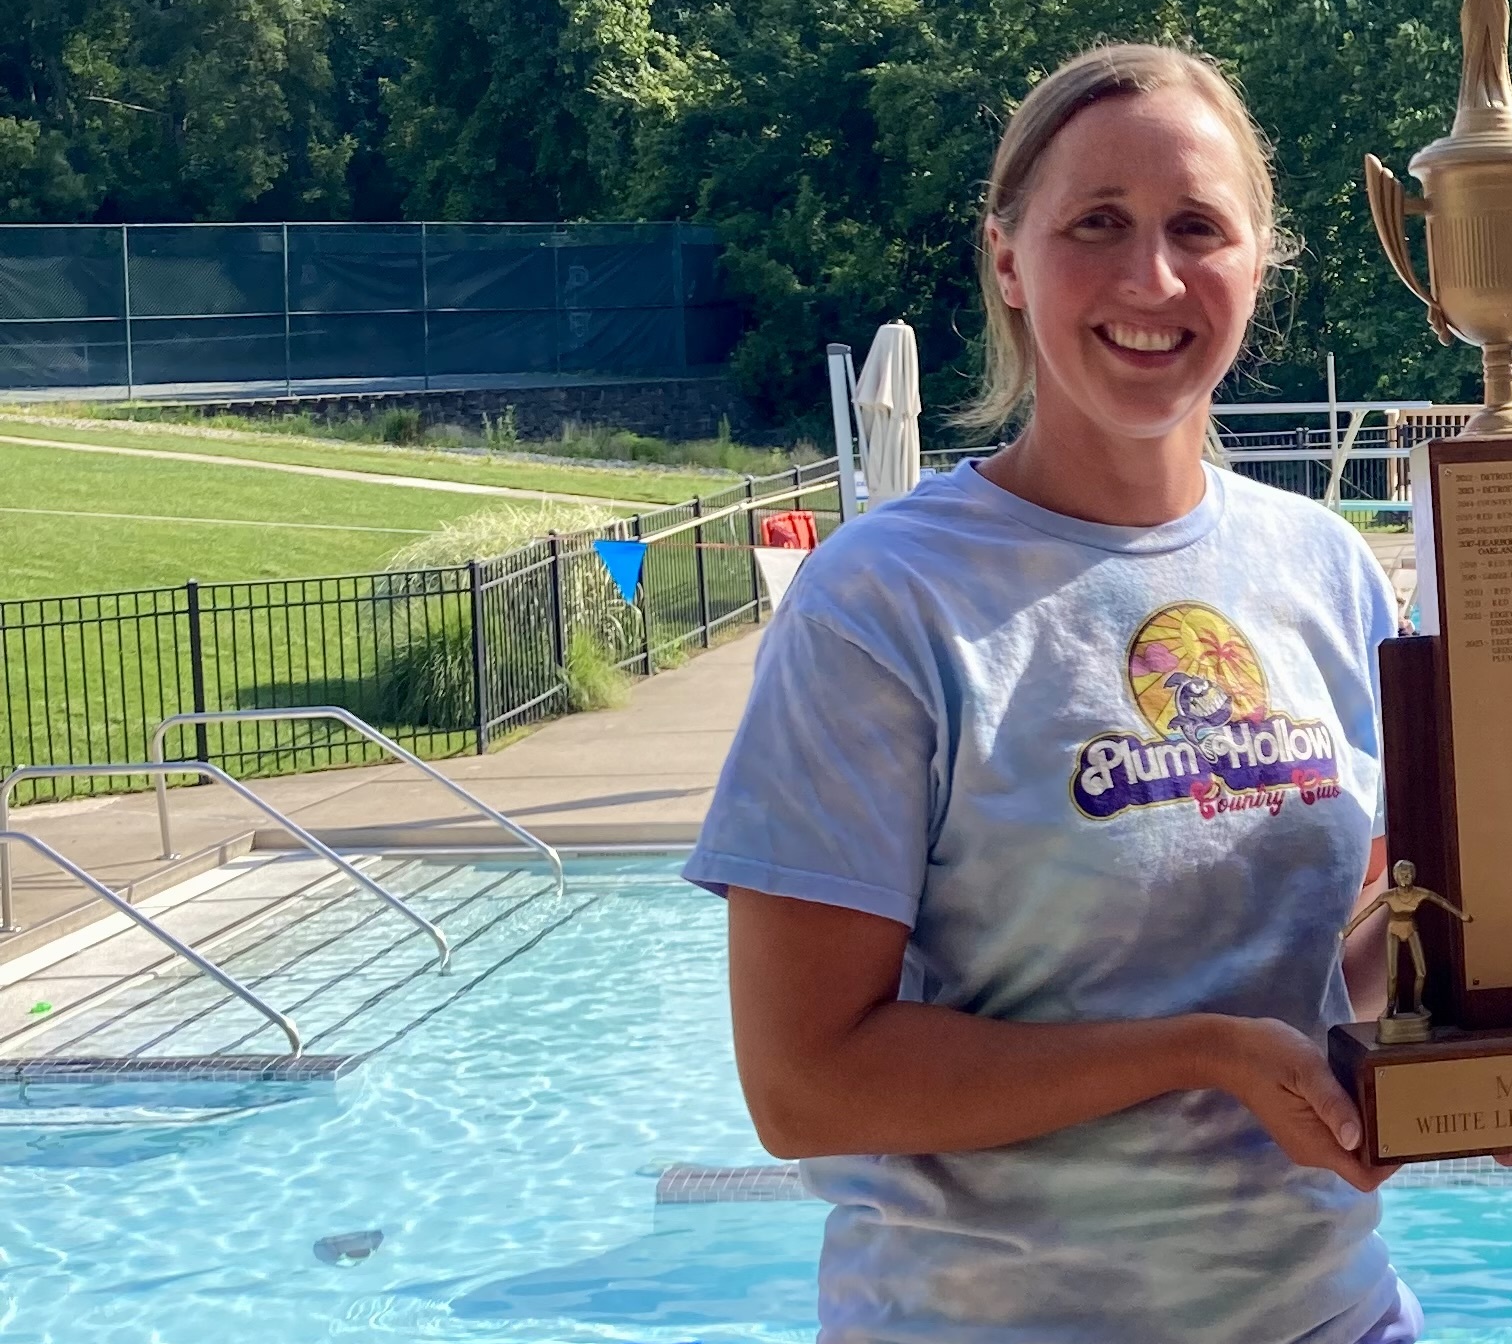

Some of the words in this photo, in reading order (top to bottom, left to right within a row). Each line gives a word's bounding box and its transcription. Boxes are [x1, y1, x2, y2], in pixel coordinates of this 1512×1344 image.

[1480, 472, 1512, 481] DETROIT
[1494, 586, 1511, 595] RED
[1492, 598, 1510, 607] RED
[1491, 627, 1512, 635] PLUM
[1081, 739, 1200, 796] Plum
[1211, 719, 1332, 769] Hollow
[1190, 779, 1286, 820] Country
[1417, 1112, 1486, 1135] WHITE
